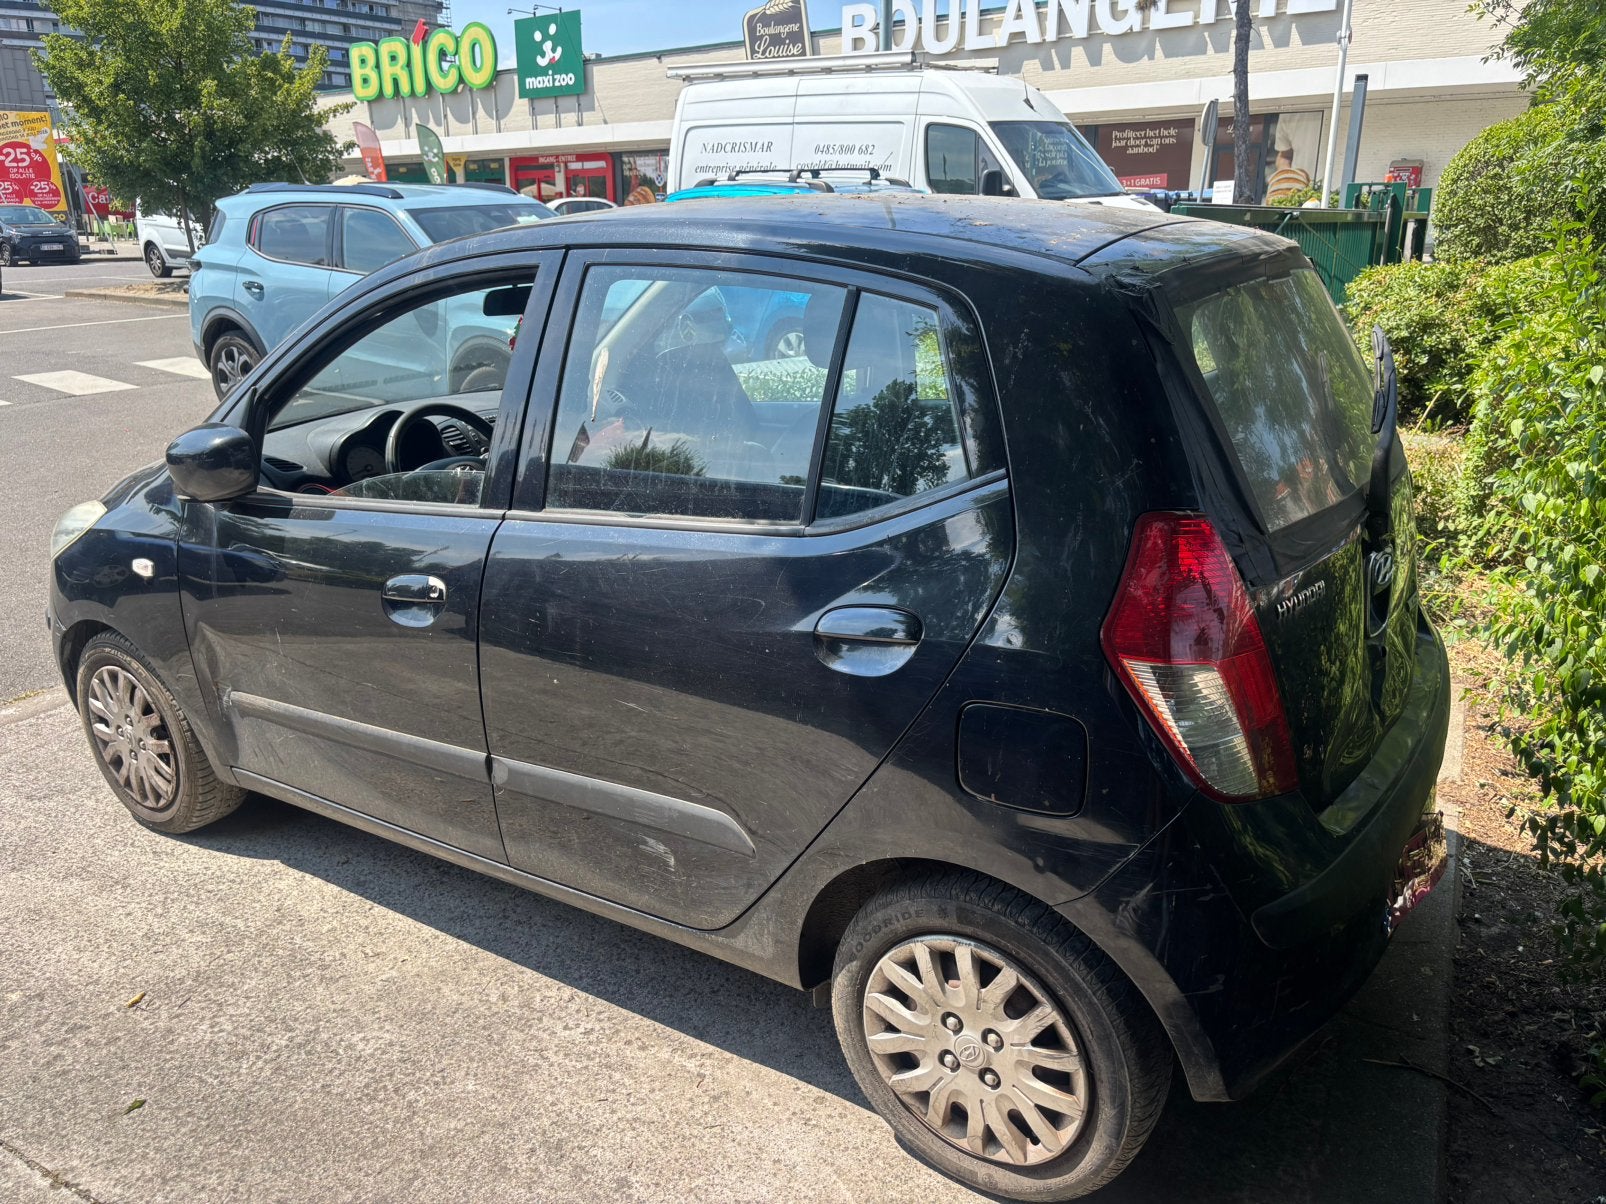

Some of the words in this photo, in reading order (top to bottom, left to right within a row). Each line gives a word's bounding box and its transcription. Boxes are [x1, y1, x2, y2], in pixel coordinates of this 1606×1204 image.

[841, 0, 1338, 58] BOULANG
[753, 35, 803, 59] Louise
[525, 72, 553, 90] maxi
[554, 72, 575, 87] zoo
[11, 114, 48, 127] moment!
[1112, 128, 1146, 139] Profiteer
[1146, 127, 1160, 137] het
[1160, 127, 1178, 136] hele
[700, 140, 774, 154] NADCRISMAR
[1112, 138, 1127, 149] jaar
[1127, 137, 1147, 146] door
[1161, 136, 1177, 145] ons
[814, 143, 856, 156] 0485/800
[857, 143, 876, 156] 682
[694, 162, 737, 176] entreprise
[738, 161, 777, 173] générale
[796, 159, 893, 172] costeld@hotmailcom
[1135, 177, 1161, 186] GRATIS
[1276, 579, 1326, 619] HYUNDAI
